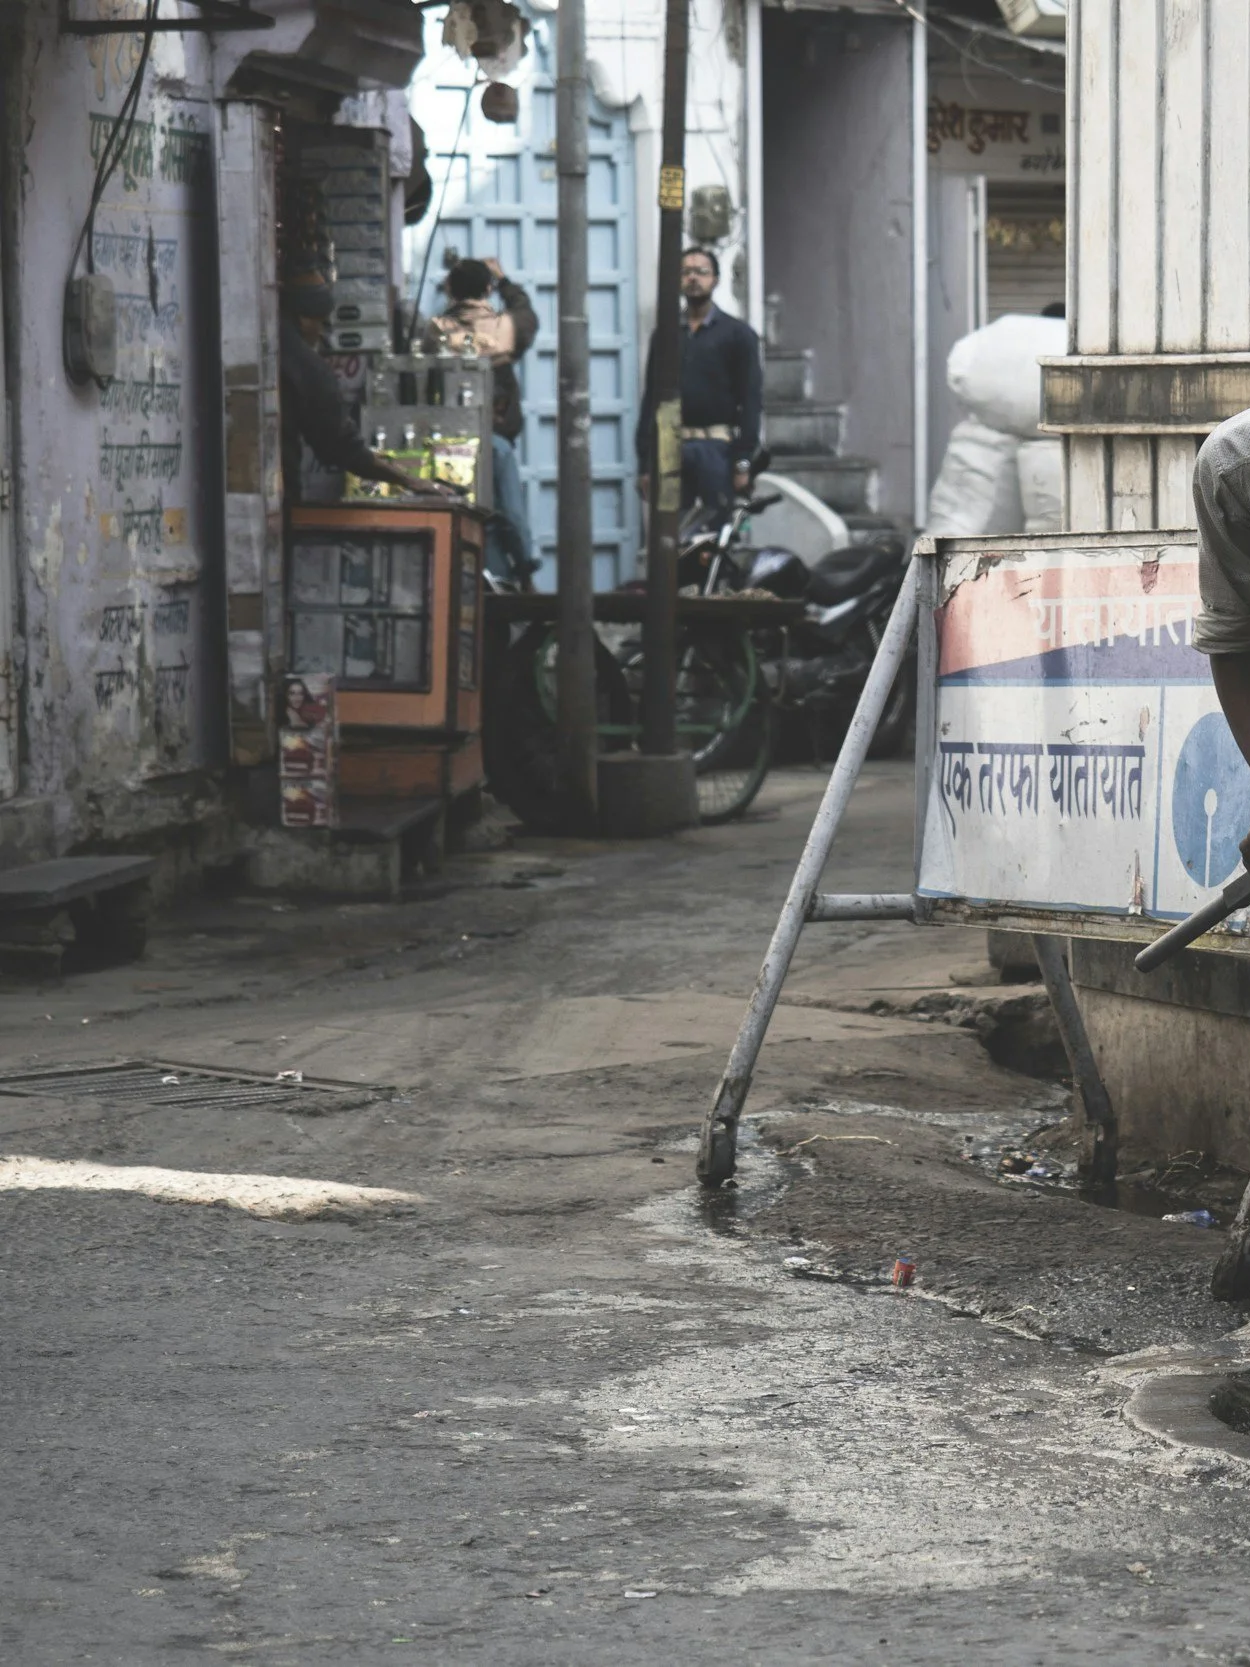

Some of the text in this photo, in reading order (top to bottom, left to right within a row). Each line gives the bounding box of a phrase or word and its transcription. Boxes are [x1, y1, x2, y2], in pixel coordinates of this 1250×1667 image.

[1028, 594, 1198, 647] यातायात
[939, 741, 1146, 840] एक तरफा यातायात
